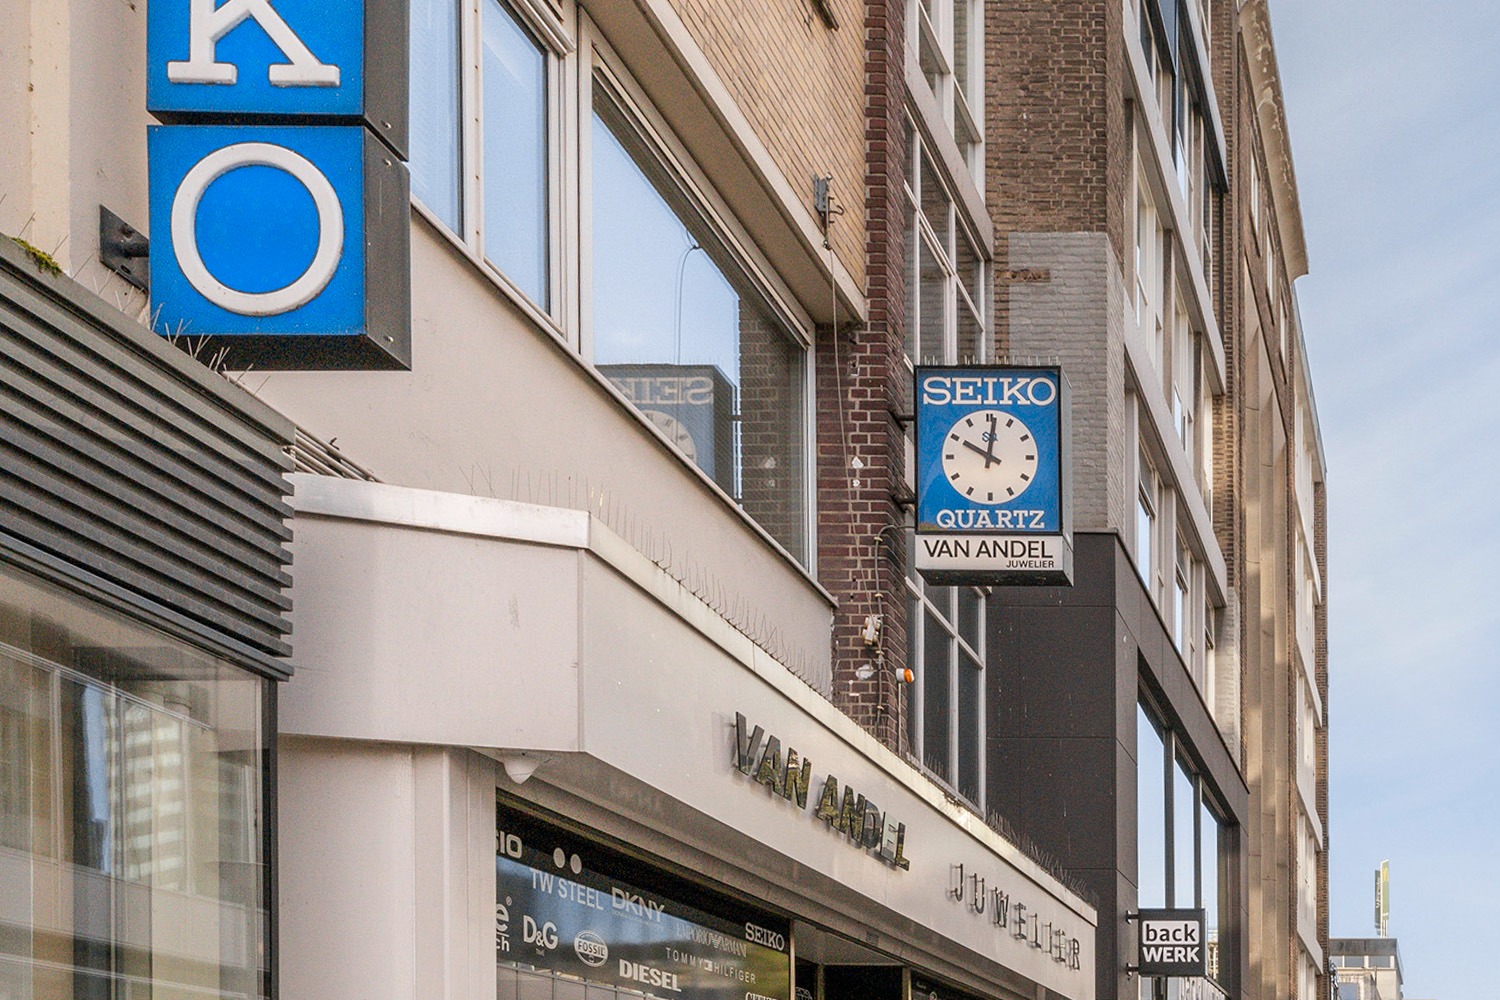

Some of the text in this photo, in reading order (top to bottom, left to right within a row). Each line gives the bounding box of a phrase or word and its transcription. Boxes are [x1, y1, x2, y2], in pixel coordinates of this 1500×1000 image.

[922, 376, 1057, 406] SEIKO
[936, 509, 1045, 529] QUARTZ
[923, 539, 1053, 559] VAN ANDEL
[1005, 560, 1055, 569] JUWELIER
[735, 711, 910, 872] VAN ANDEL
[496, 829, 522, 859] IO
[529, 868, 604, 912] TW STEEL
[612, 886, 665, 923] DKNY
[523, 914, 559, 950] D&G
[954, 863, 1081, 971] JUWELIER
[745, 922, 785, 951] SEIKO
[1145, 923, 1197, 942] back
[577, 939, 606, 957] FOSSIL
[1142, 946, 1200, 963] WERK
[619, 958, 682, 992] DIESEL
[665, 947, 757, 984] TOMMY HILFIGER
